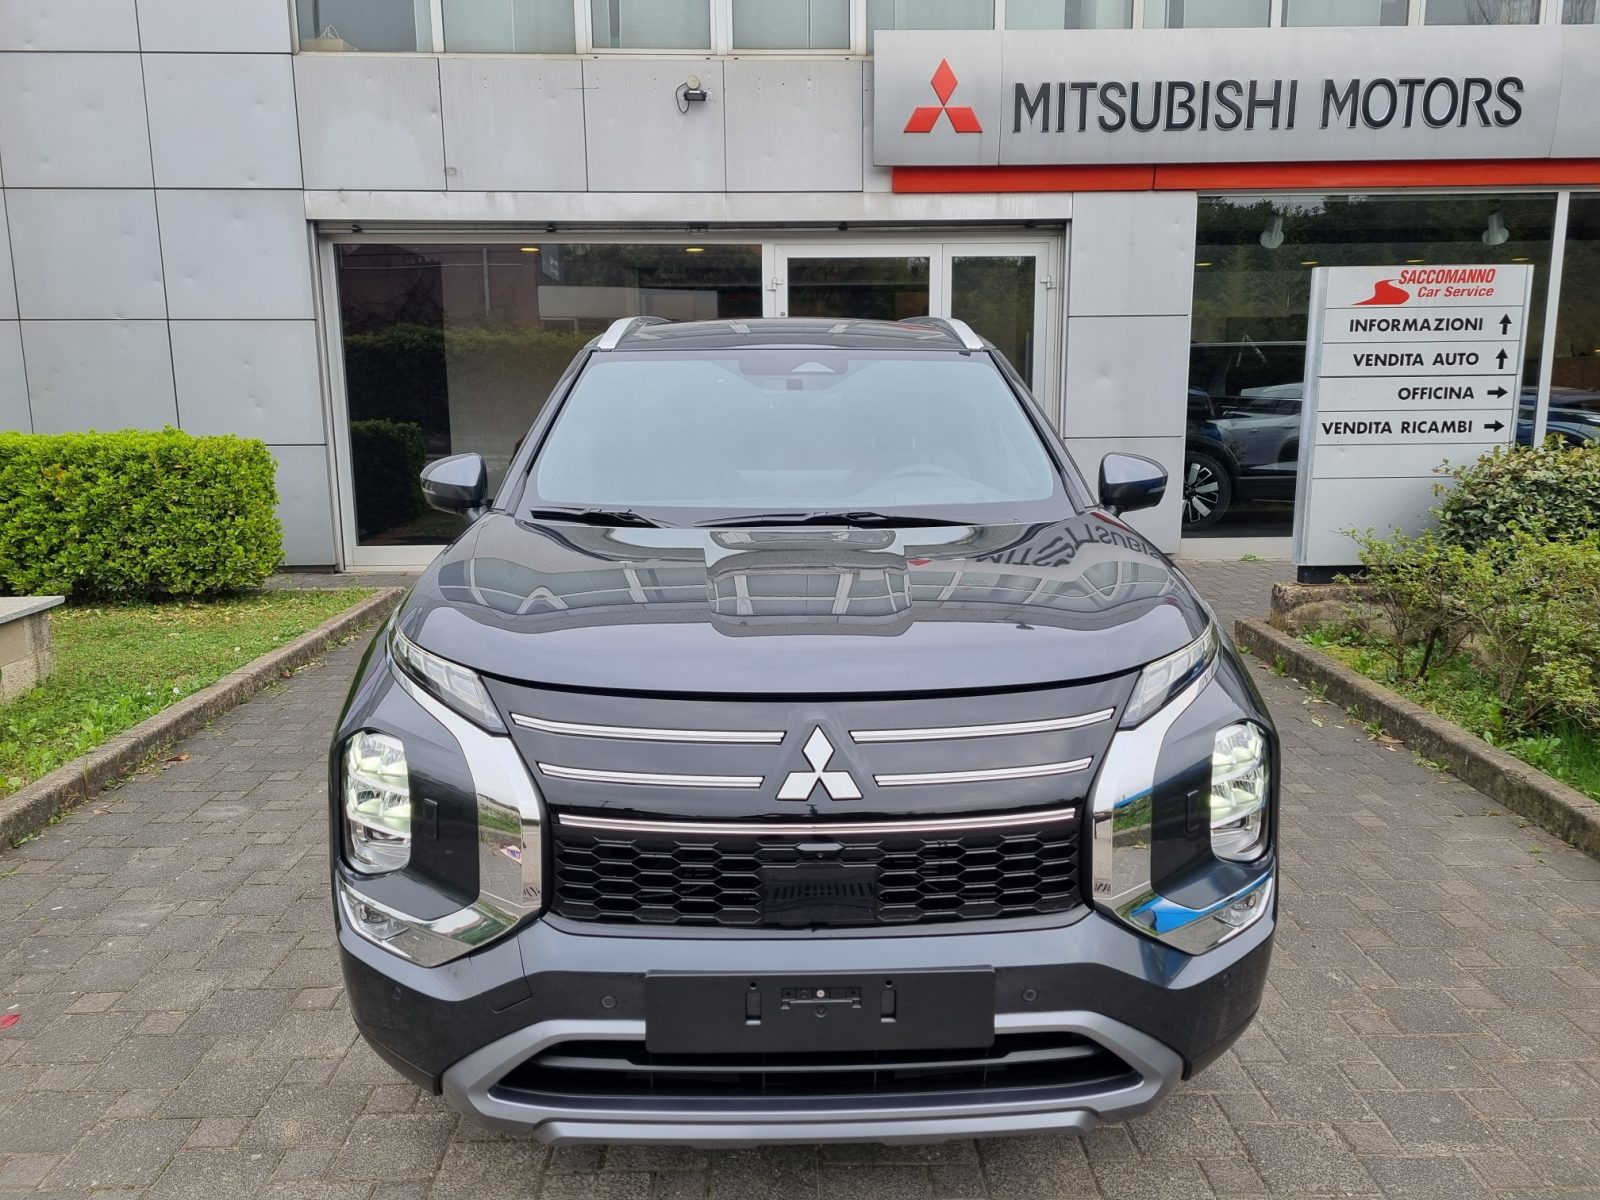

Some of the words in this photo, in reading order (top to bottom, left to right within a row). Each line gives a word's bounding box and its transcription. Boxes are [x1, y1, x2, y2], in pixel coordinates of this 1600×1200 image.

[1012, 79, 1299, 133] MITSUBISHI
[1319, 76, 1525, 129] MOTORS
[1399, 268, 1496, 284] SACCOMANNO
[1417, 286, 1441, 298] Car
[1444, 286, 1494, 297] Service
[1349, 318, 1483, 332] INFORMAZIONI
[1353, 353, 1424, 367] VENDITA
[1432, 352, 1479, 366] AUTO
[1398, 386, 1474, 400] OFFICINA
[1322, 421, 1392, 435] VENDITA
[1400, 420, 1472, 434] RICAMBI
